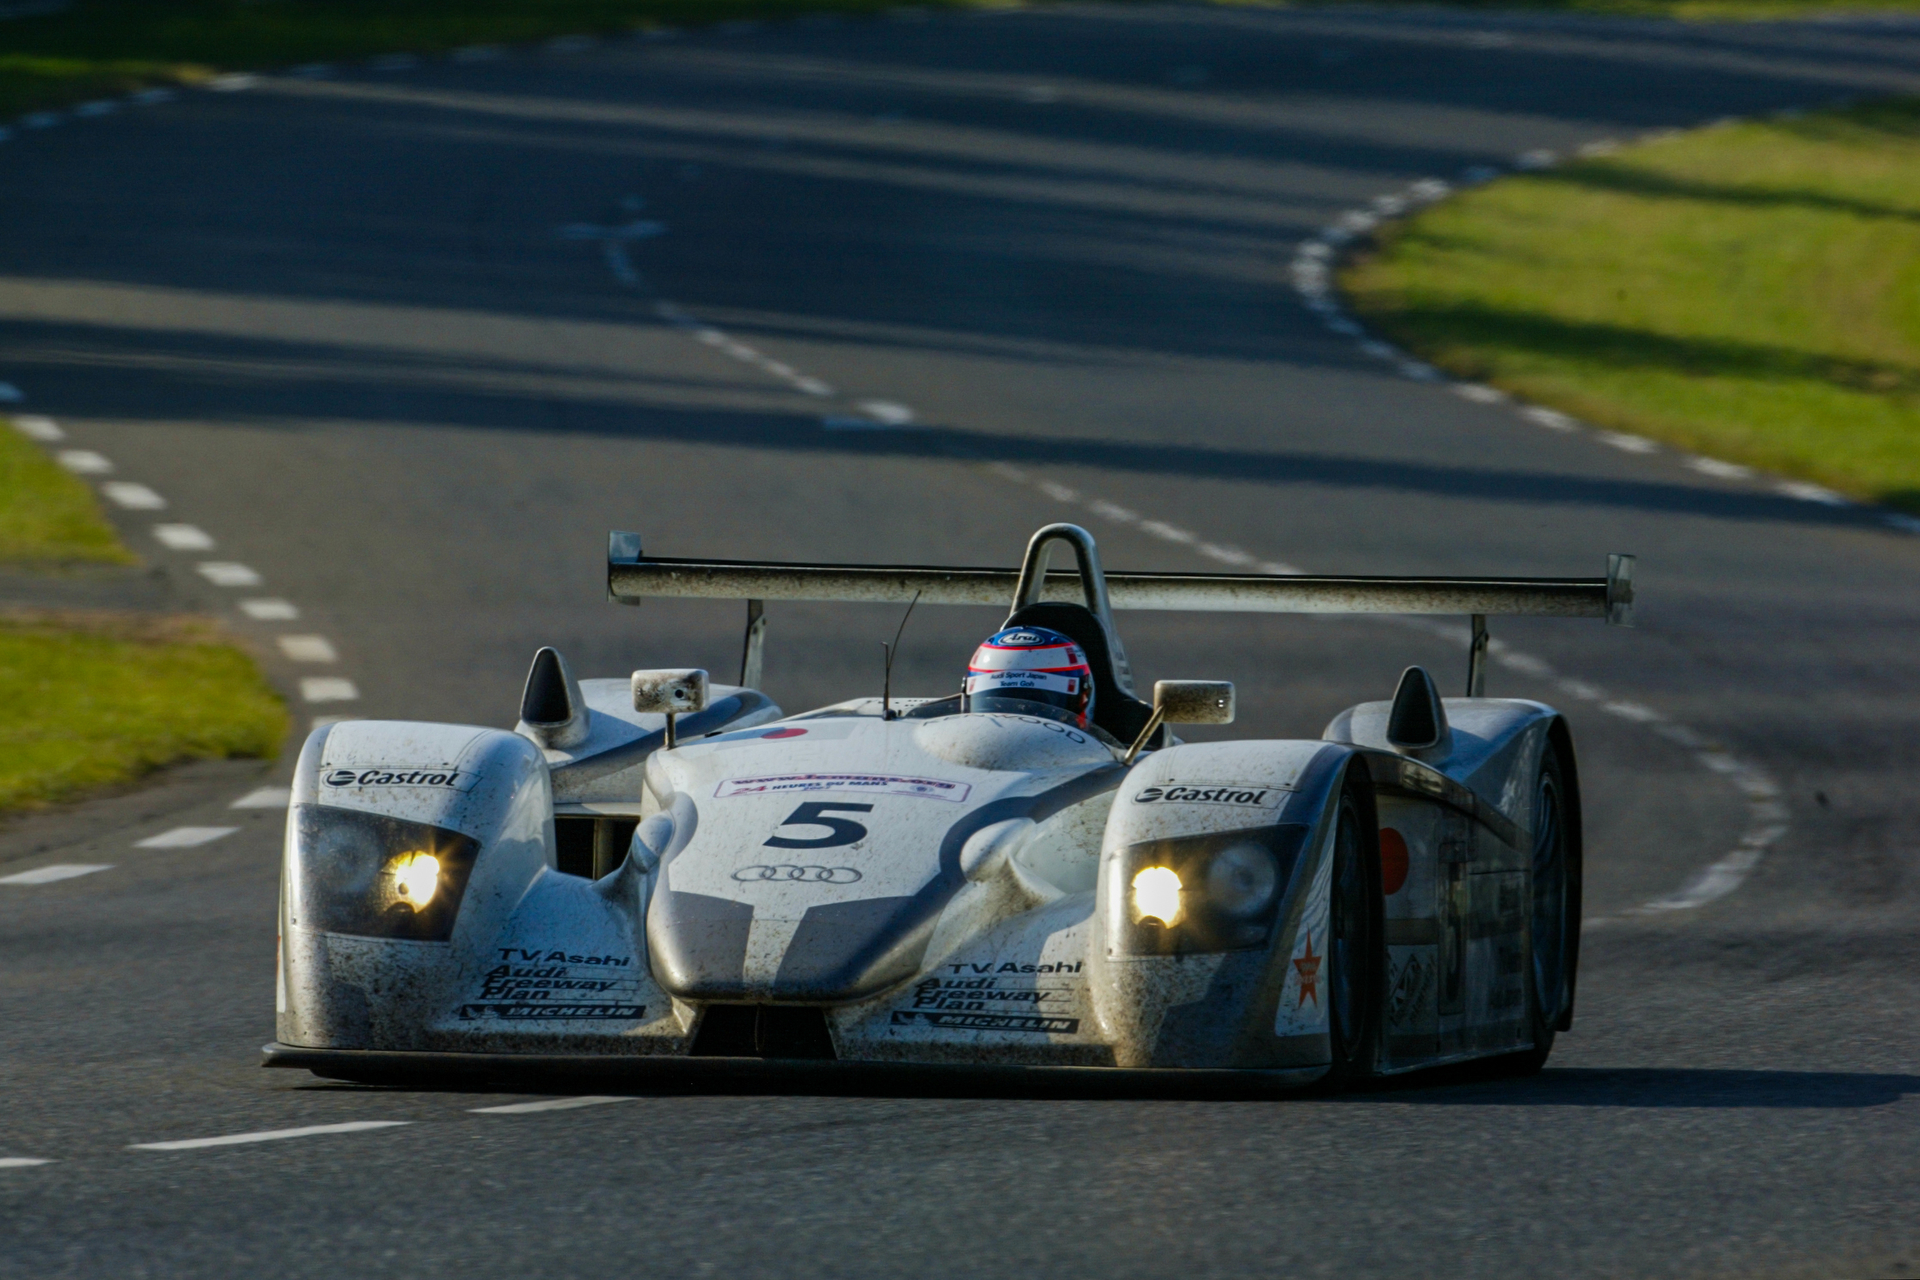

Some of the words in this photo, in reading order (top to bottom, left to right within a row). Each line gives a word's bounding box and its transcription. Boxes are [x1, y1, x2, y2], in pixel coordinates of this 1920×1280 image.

[990, 672, 1004, 680] Audi
[1005, 671, 1025, 680] Sport
[1026, 671, 1048, 681] Japan
[357, 770, 459, 787] Castrol
[731, 774, 956, 790] www.lemans.org
[729, 785, 769, 797] 24
[772, 782, 821, 790] HEURES
[1164, 787, 1267, 805] Castrol
[763, 801, 875, 849] 5
[498, 948, 542, 961] TV
[543, 950, 630, 966] Asahi
[485, 966, 566, 978] Audi
[948, 963, 993, 974] TV
[995, 961, 1083, 973] Asahi
[481, 976, 617, 992] Freeway
[917, 977, 998, 989] Audi
[479, 987, 551, 1000] Plan
[914, 988, 1050, 1004] Freeway
[912, 997, 985, 1010] Plan
[507, 1007, 636, 1017] MICHELIN
[939, 1016, 1072, 1030] MICHELIN
